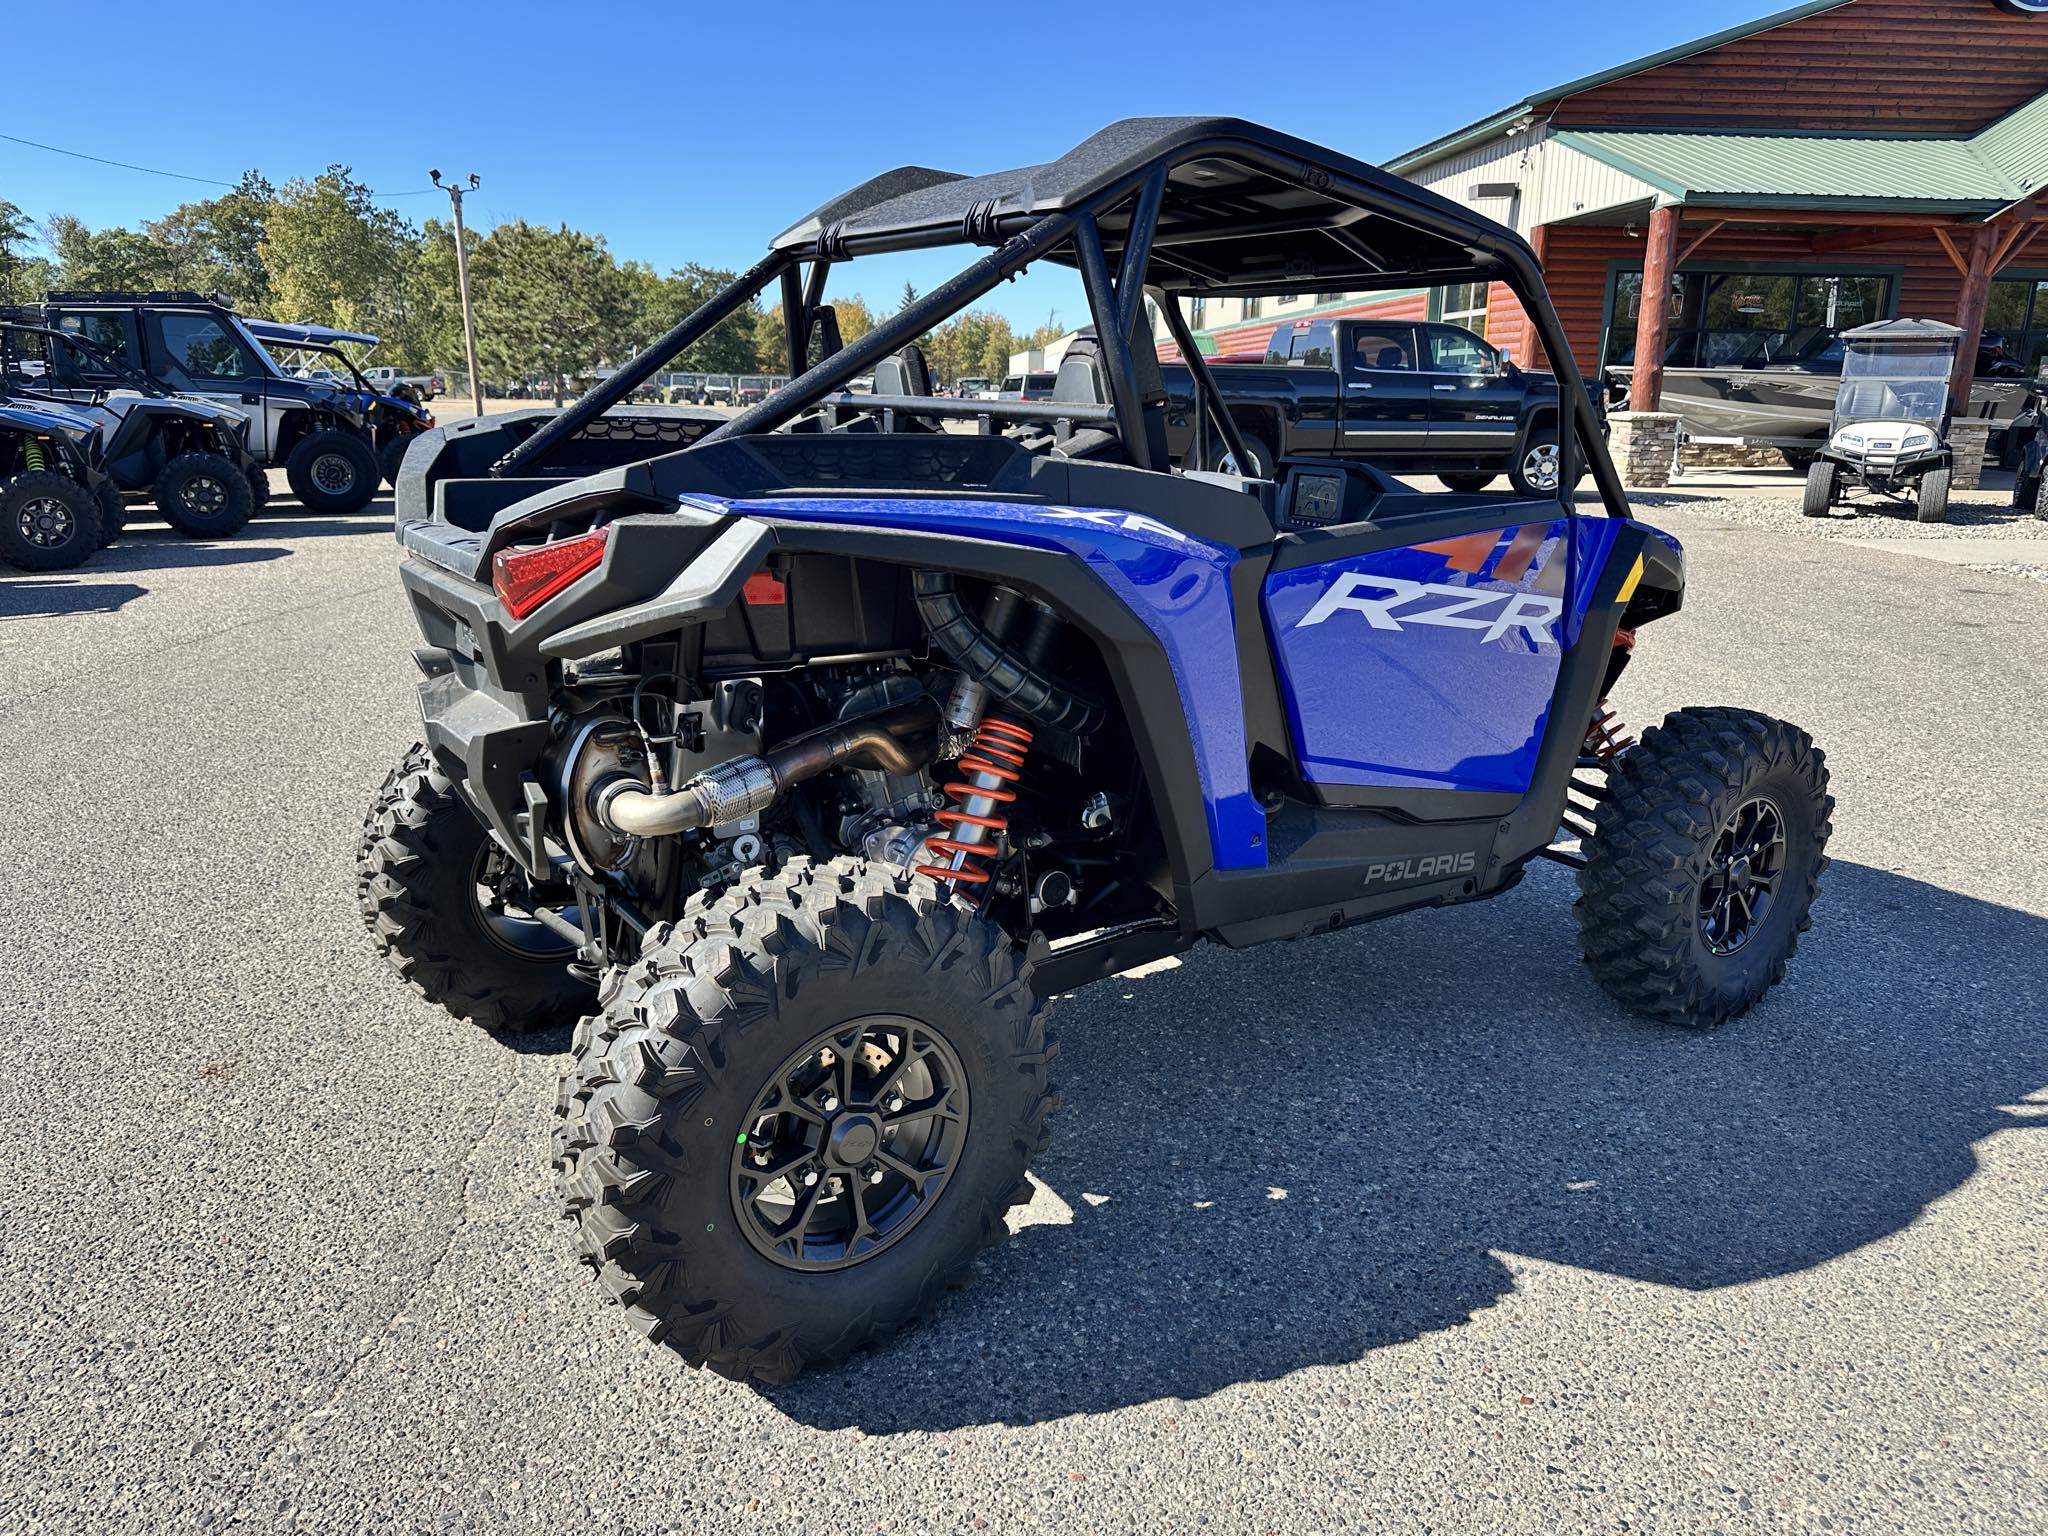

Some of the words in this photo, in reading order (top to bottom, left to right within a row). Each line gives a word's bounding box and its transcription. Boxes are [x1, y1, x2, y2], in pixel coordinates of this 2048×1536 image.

[1034, 506, 1187, 543] XP
[1295, 572, 1563, 645] RZR
[1363, 851, 1475, 885] POLARIS
